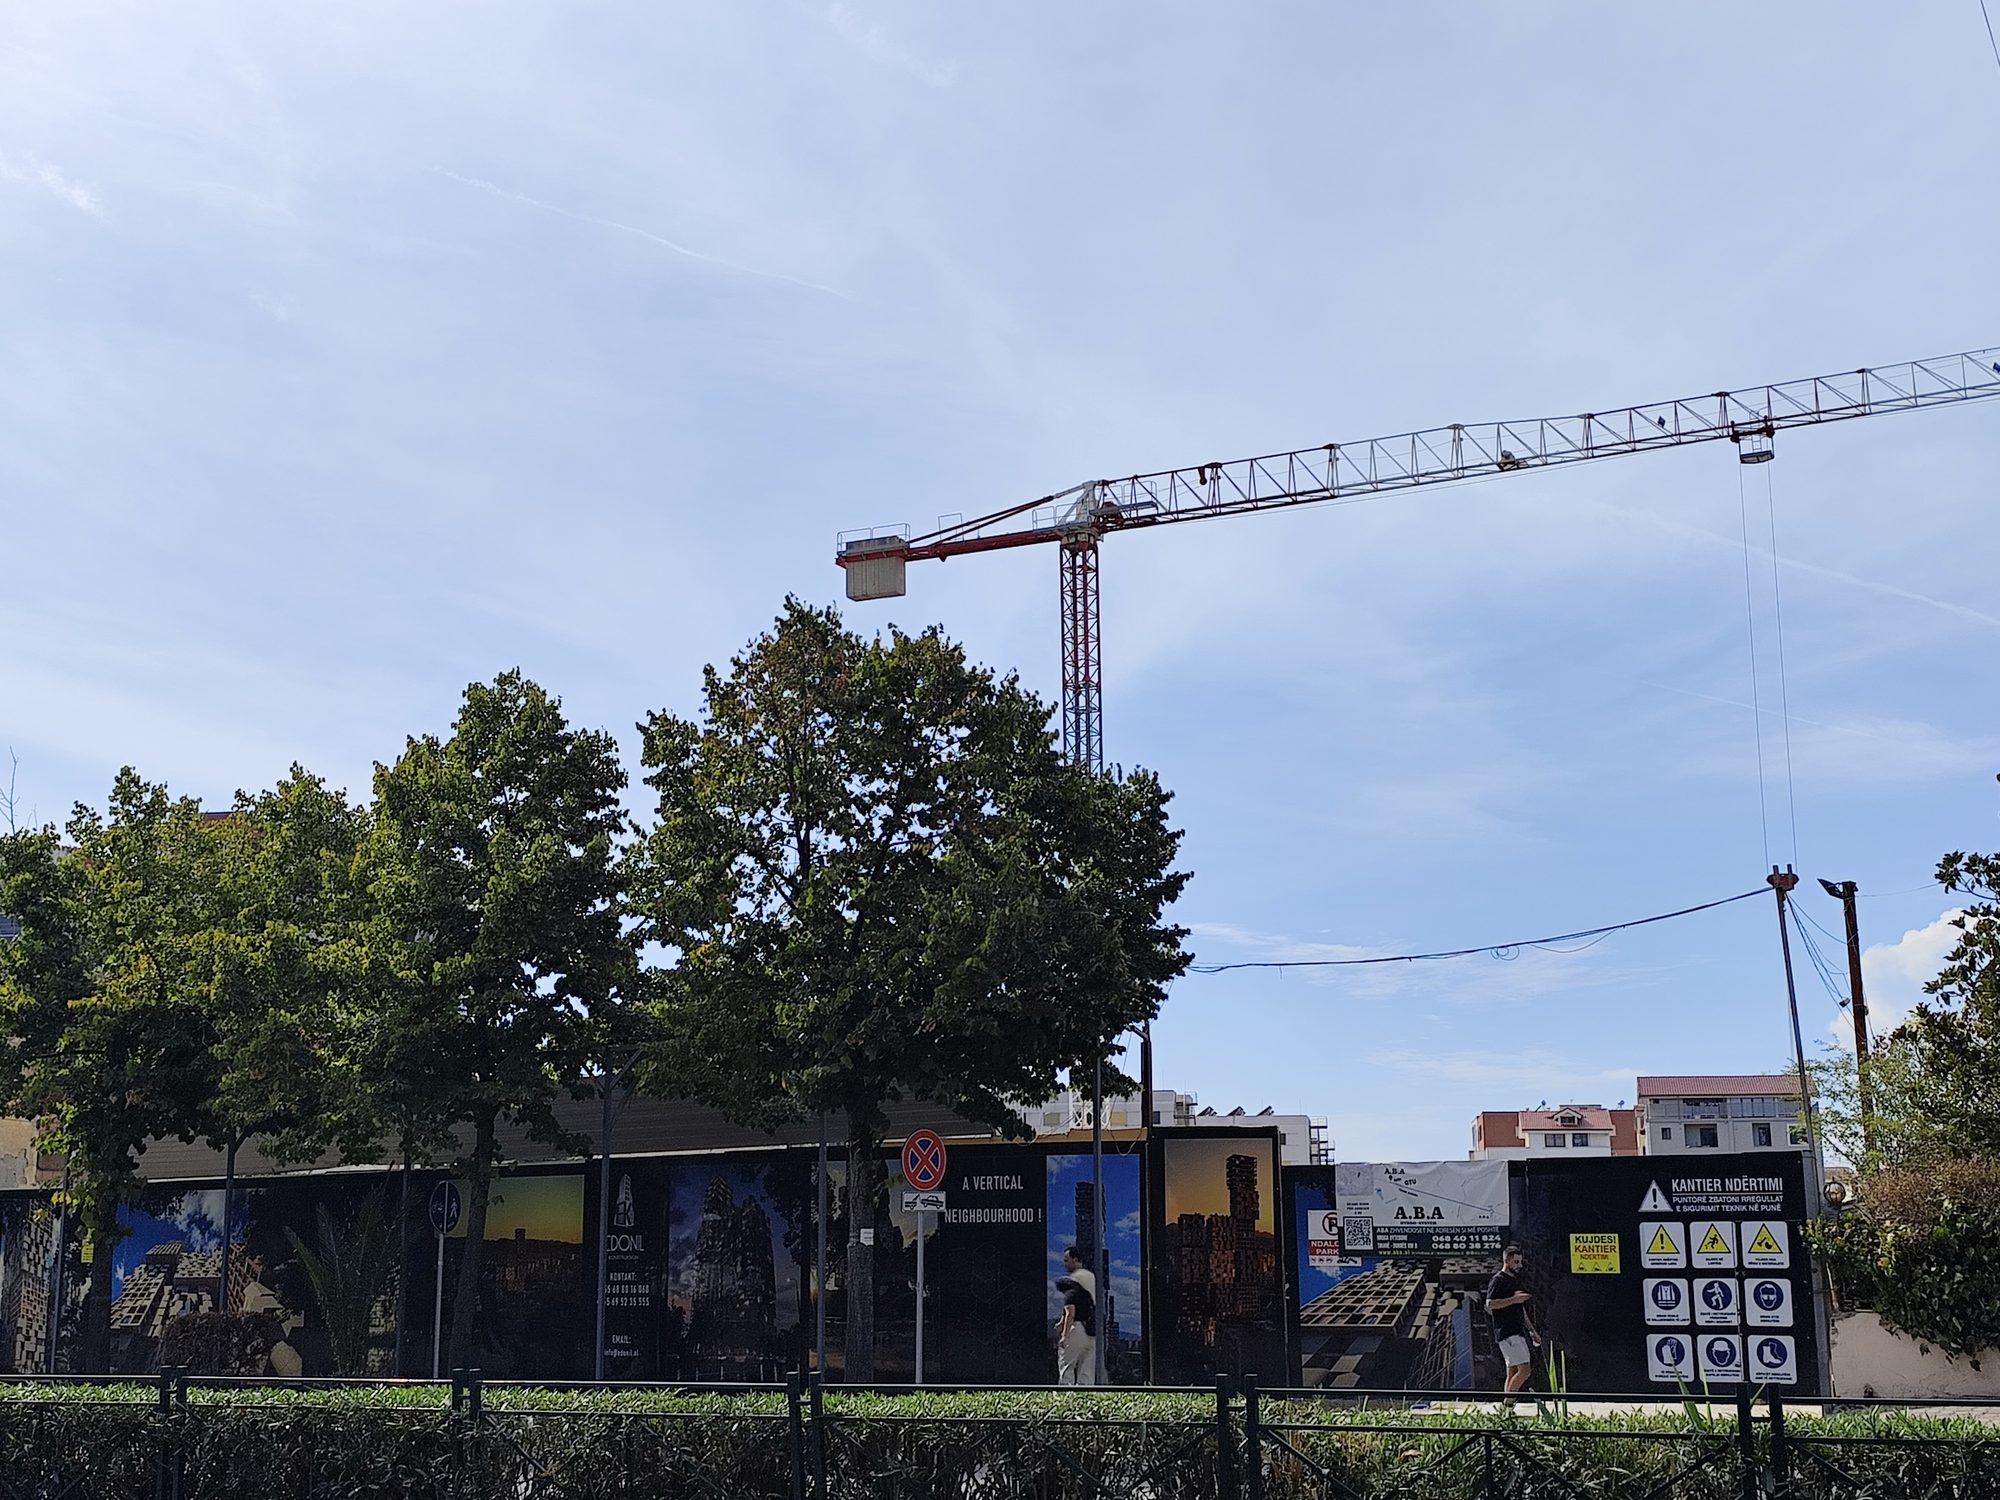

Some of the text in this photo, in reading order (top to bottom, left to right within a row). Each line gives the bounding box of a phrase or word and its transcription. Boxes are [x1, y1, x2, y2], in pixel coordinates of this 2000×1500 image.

[962, 1175, 1024, 1190] A VERTICAL
[1672, 1175, 1782, 1192] KANTIER NDËRTIMI
[945, 1208, 1042, 1223] NEIGHBOURHOOD !
[1394, 1206, 1444, 1220] A.B.A
[1575, 1236, 1616, 1244] KUJDES!
[1575, 1245, 1616, 1253] KANTIER
[610, 1272, 637, 1281] KONTAKT:
